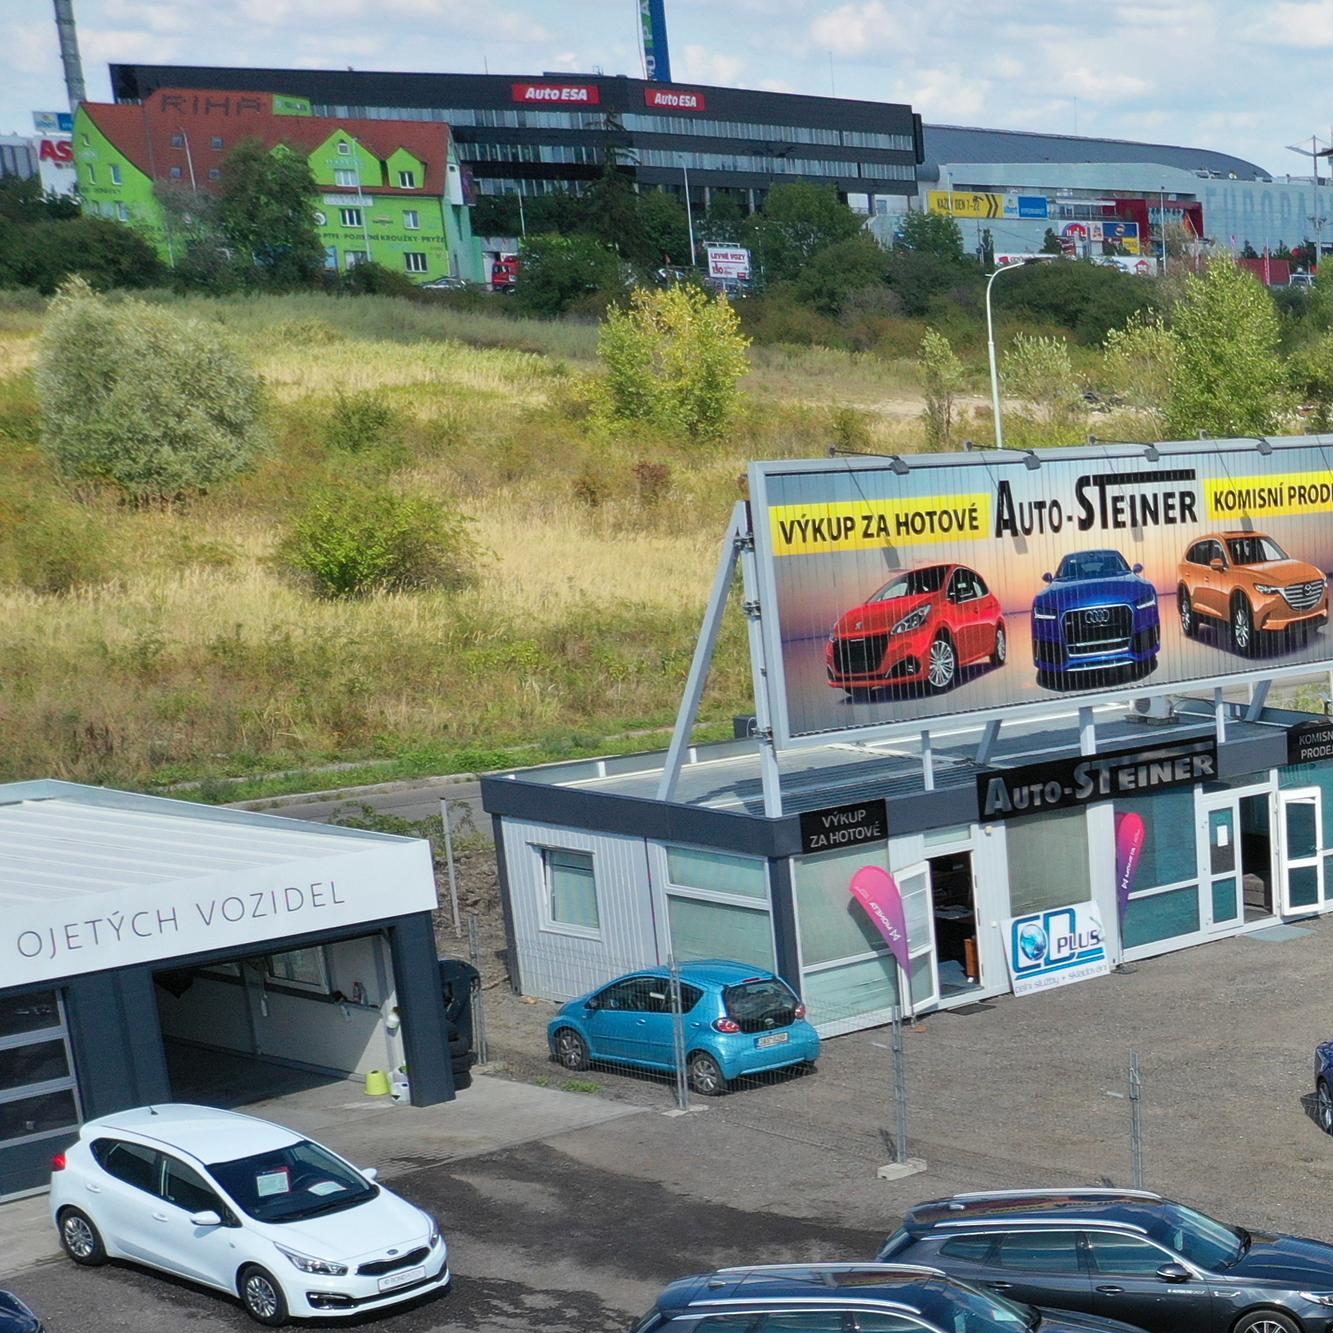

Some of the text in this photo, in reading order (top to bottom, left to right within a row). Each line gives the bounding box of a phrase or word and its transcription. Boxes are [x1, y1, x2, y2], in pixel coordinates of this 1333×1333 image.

[561, 88, 588, 101] ESA
[1213, 481, 1284, 512] KOMISNÍ
[779, 502, 980, 545] VÝKUP ZA HOTOVÉ
[821, 808, 867, 828] VÝKUP
[809, 820, 882, 848] ZA HOTOVÉ
[16, 880, 346, 960] OJETÝCH VOZIDEL
